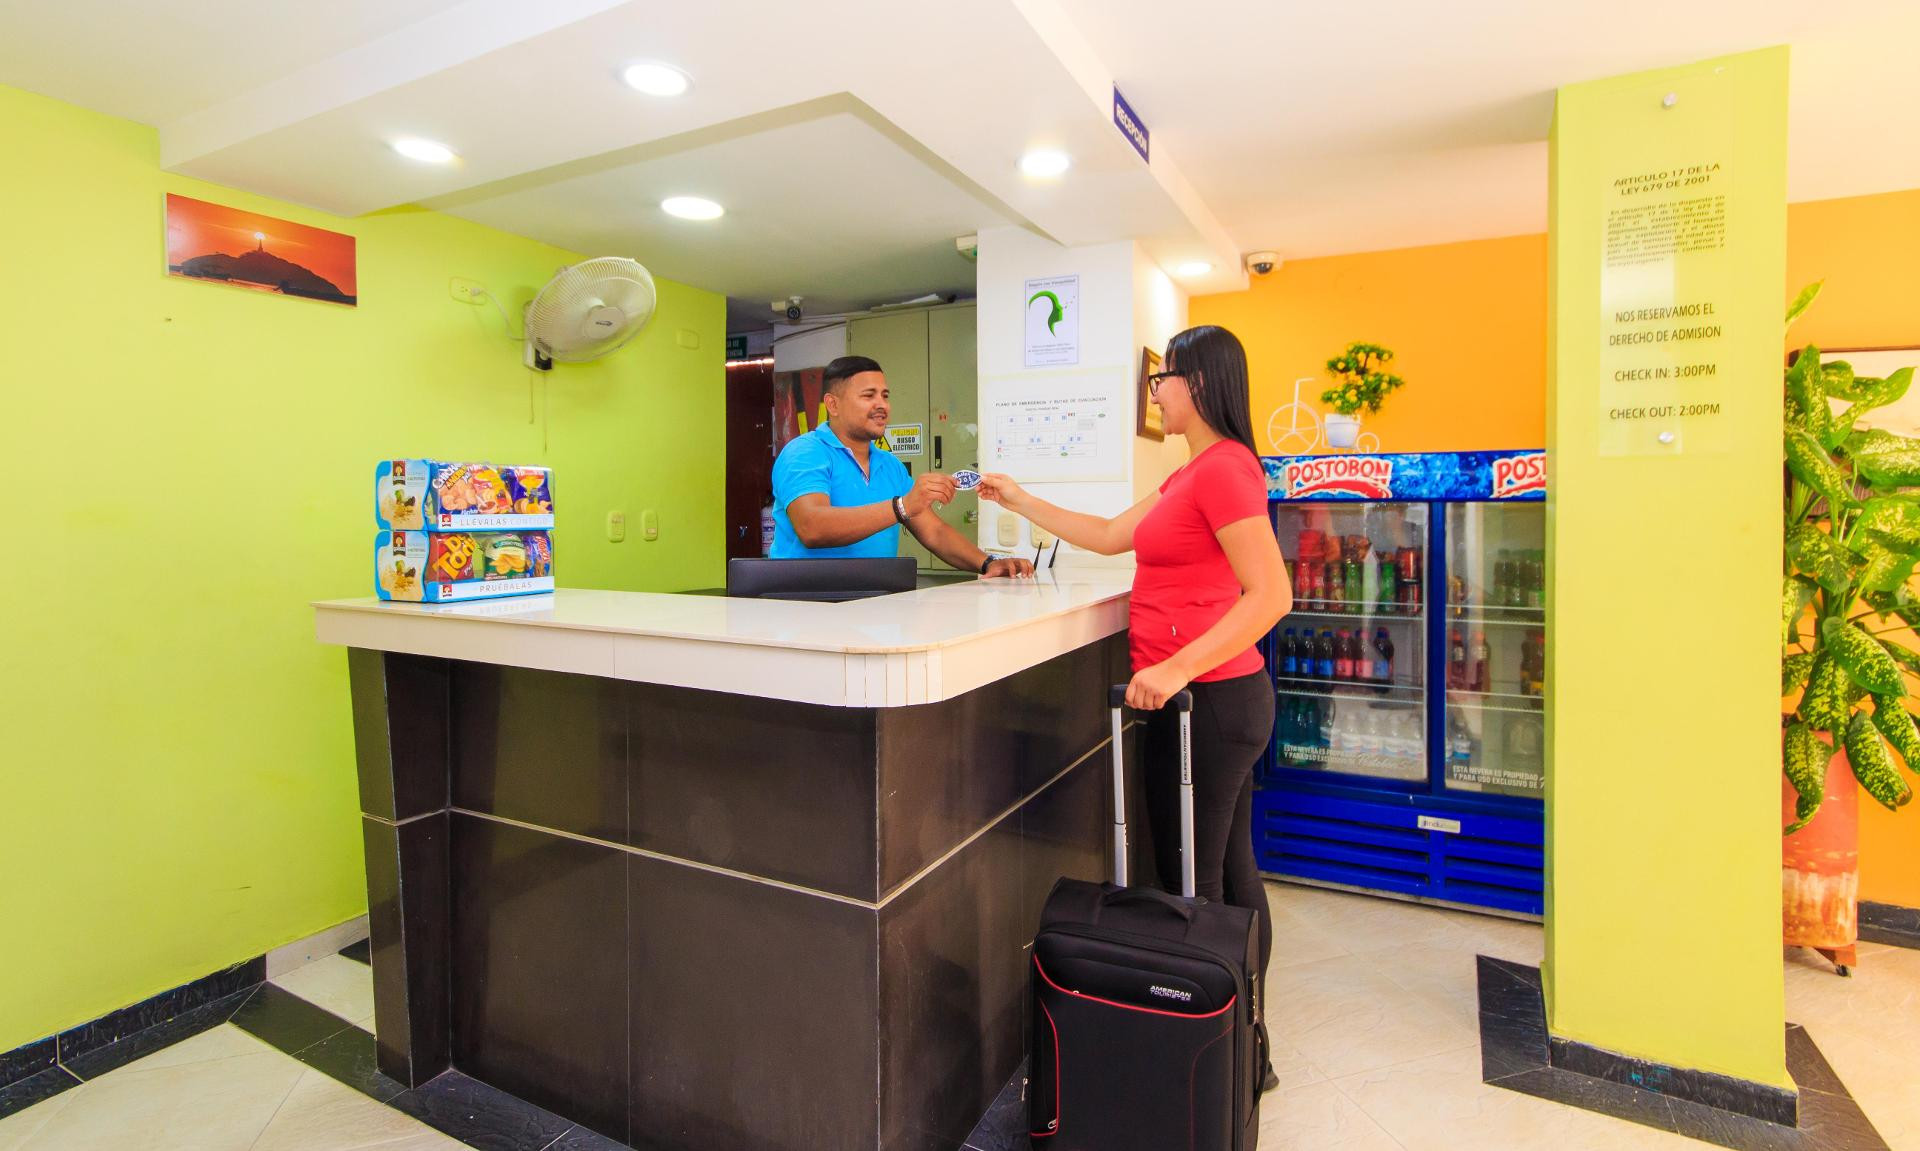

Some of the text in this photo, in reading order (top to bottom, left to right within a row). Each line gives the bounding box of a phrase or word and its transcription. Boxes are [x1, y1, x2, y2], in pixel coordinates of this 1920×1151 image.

[1614, 163, 1721, 187] ARTICULO 17 DE LA
[1621, 175, 1710, 196] LEY 679 DE 2001
[1615, 303, 1714, 323] NOS RESERVAMOS EL
[1609, 326, 1721, 346] DERECHO DE ADMISION
[1614, 364, 1716, 382] CHECK IN: 3:00PM
[1610, 403, 1720, 420] CHECK OUT: 2:00PM
[892, 443, 920, 451] ELECTRICO
[1287, 458, 1390, 489] POSTOBON
[1496, 455, 1546, 488] POST
[1453, 765, 1538, 781] ESTA NEVERA ES PROPIEDAD
[1459, 773, 1476, 782] PARA
[1477, 775, 1491, 783] USO
[1492, 777, 1528, 787] EXCLUSIVO
[1529, 780, 1538, 789] DE
[1150, 985, 1192, 998] AMERICAN
